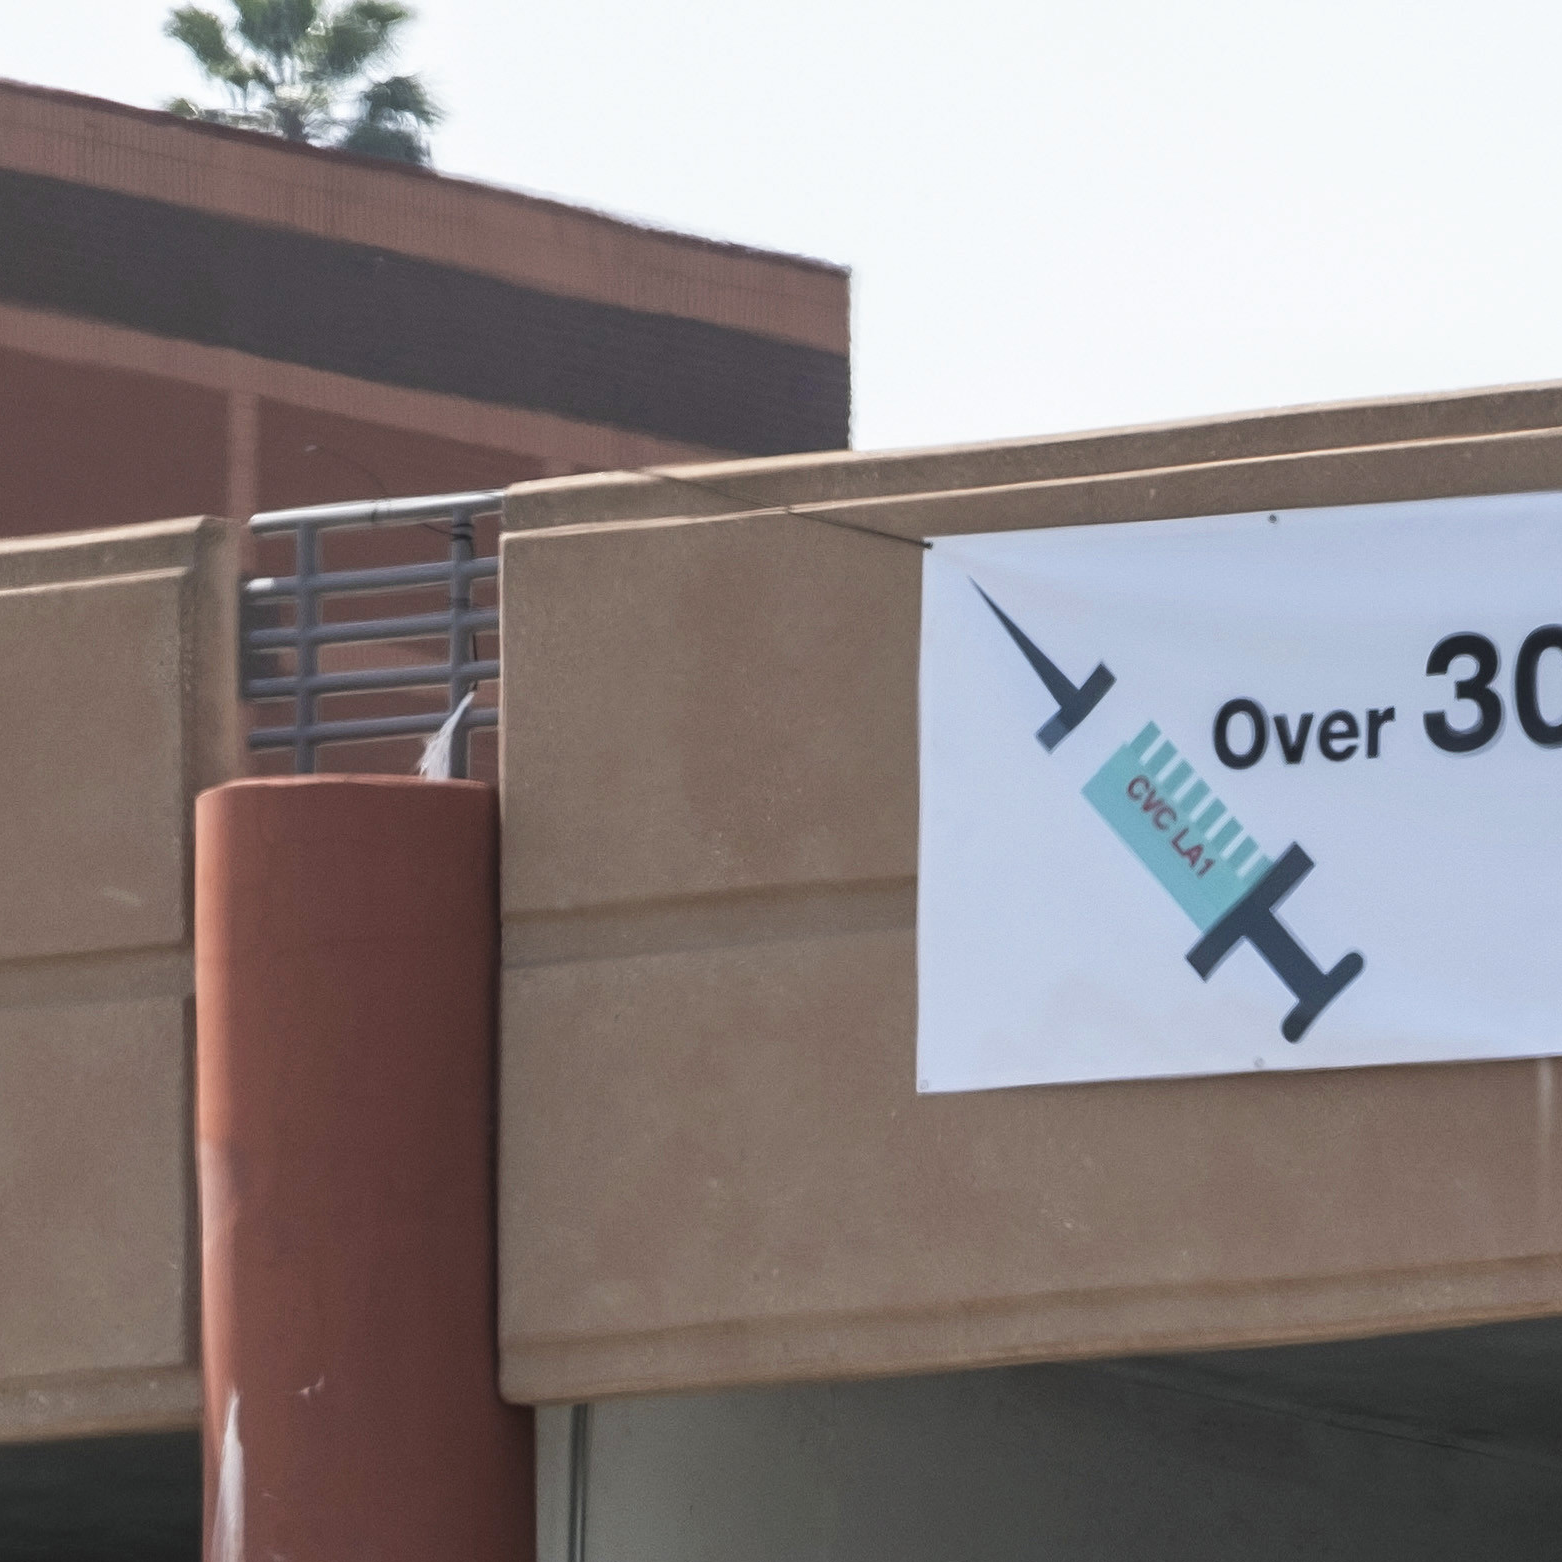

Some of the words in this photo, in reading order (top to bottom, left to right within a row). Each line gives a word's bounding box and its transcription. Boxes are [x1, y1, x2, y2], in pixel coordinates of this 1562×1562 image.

[1211, 697, 1397, 771] Over
[1127, 774, 1177, 831] CVC
[1170, 827, 1216, 879] LA1
